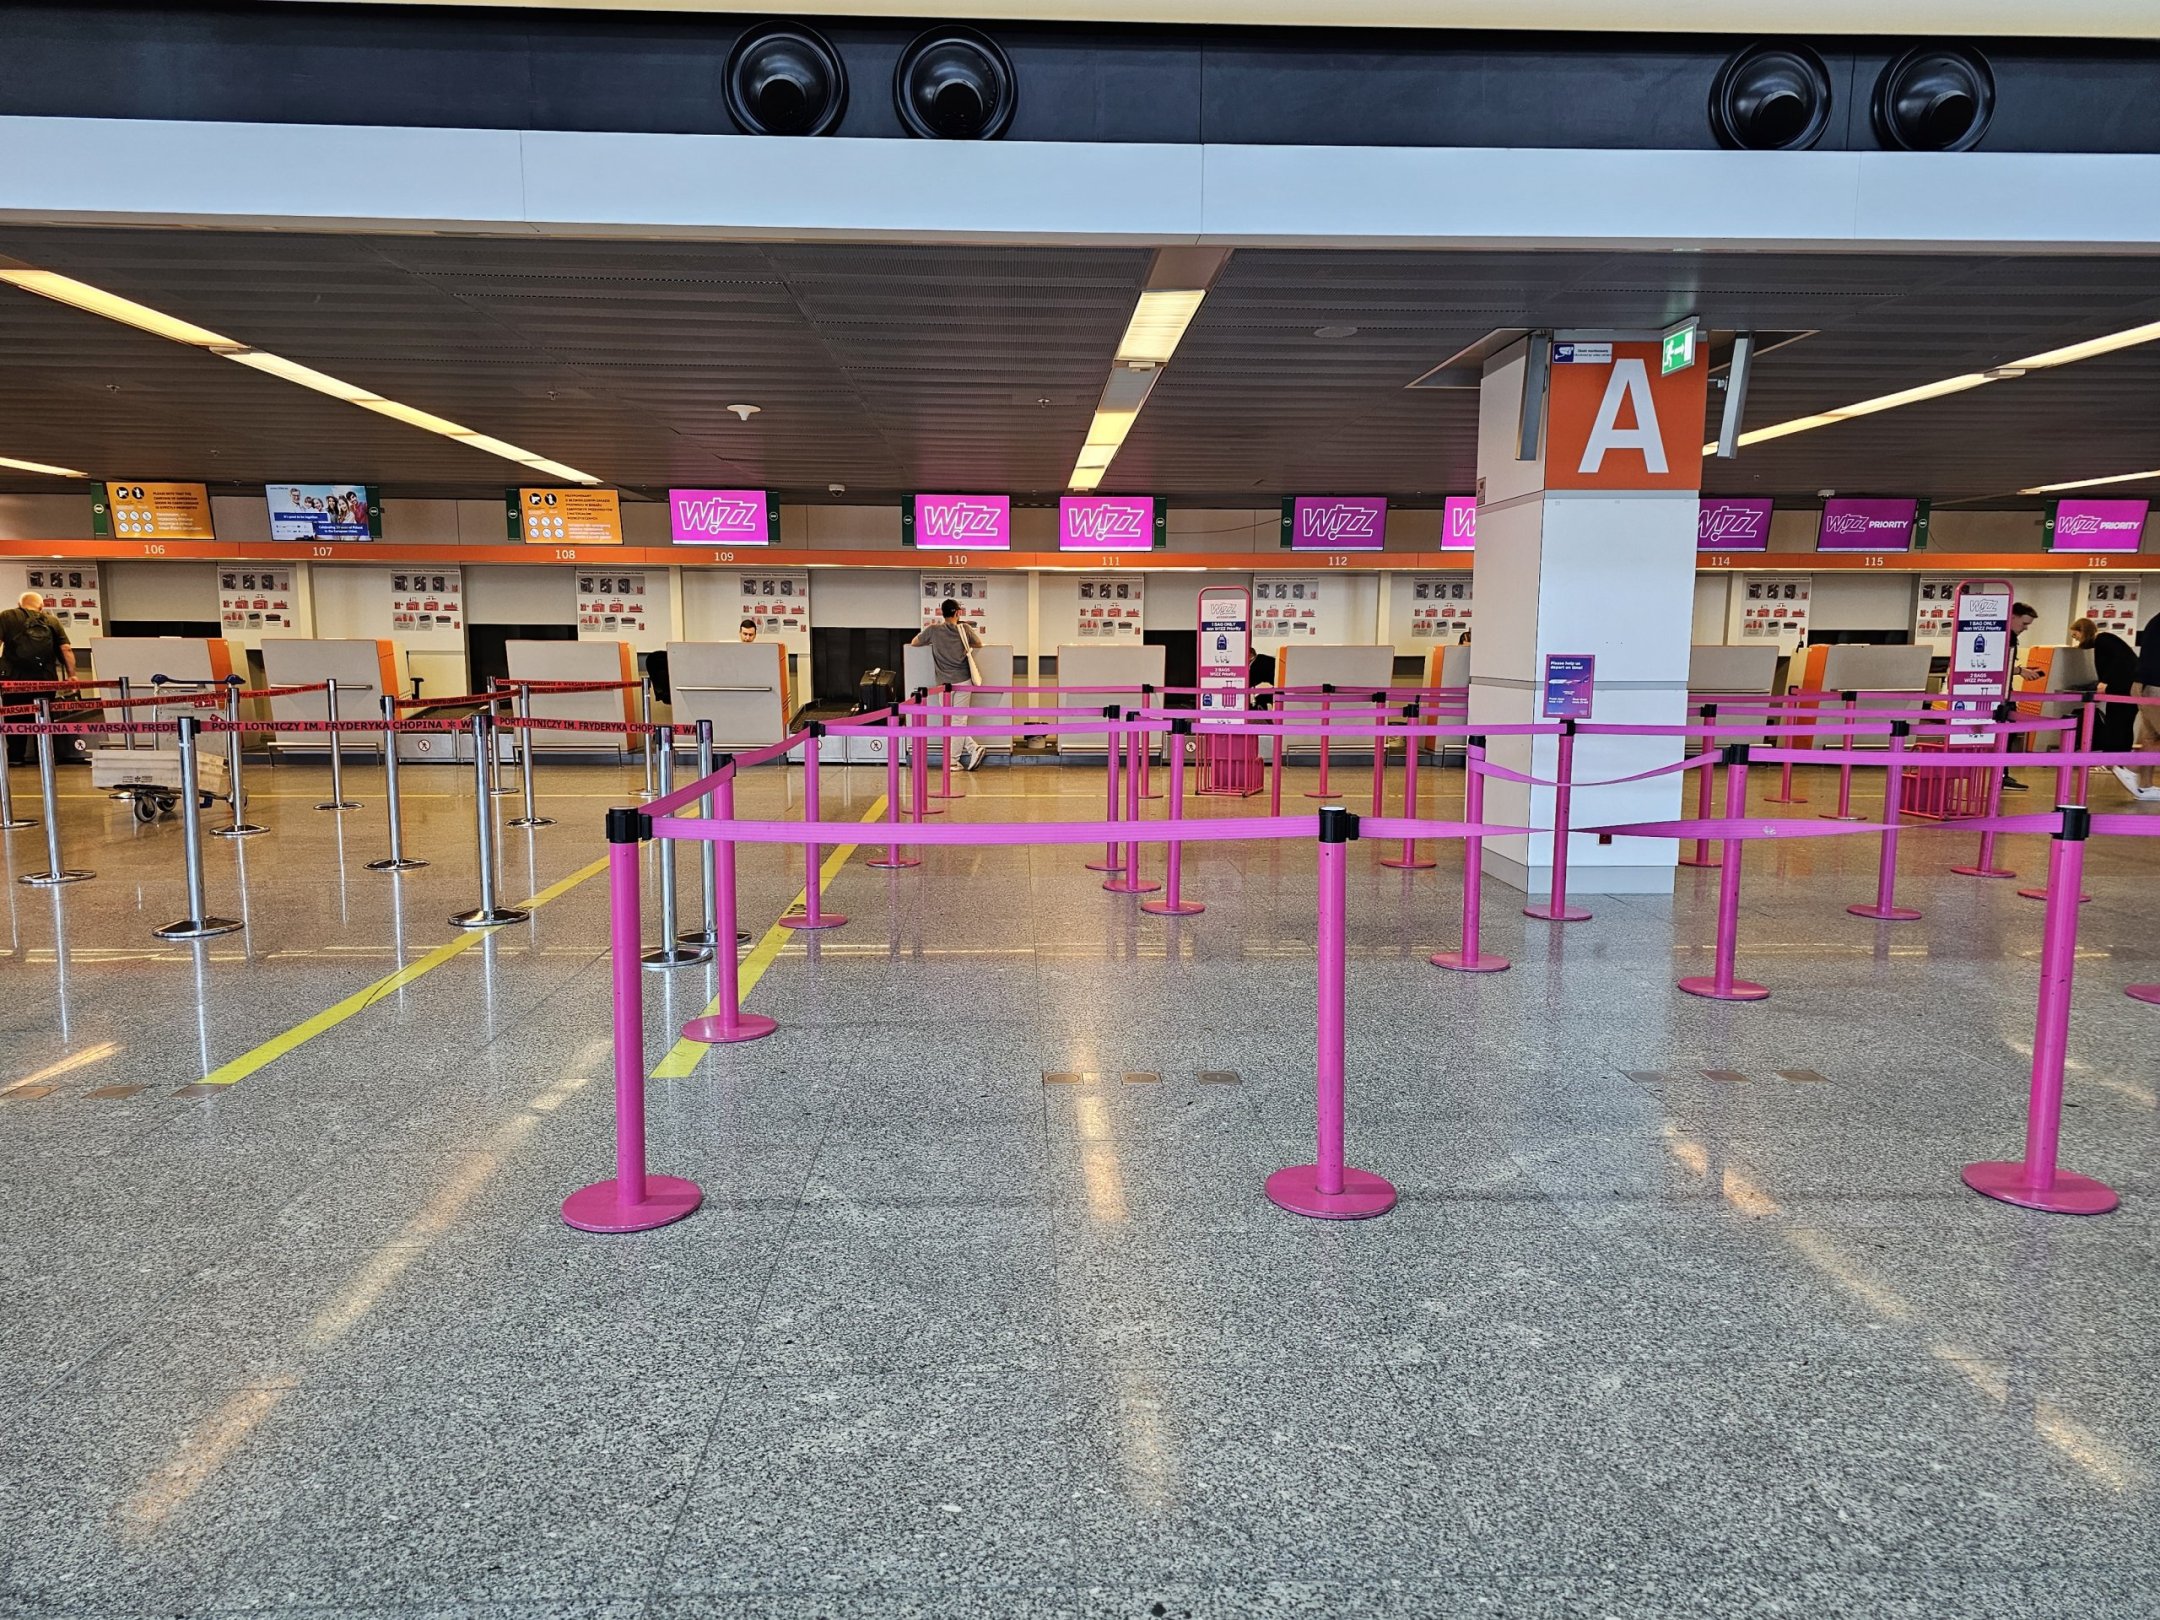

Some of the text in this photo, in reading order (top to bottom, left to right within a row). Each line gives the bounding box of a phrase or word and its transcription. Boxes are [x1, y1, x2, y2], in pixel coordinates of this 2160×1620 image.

[1578, 359, 1669, 473] A
[1869, 520, 1908, 529] PRIORITY
[2099, 521, 2140, 530] PRIORITY
[144, 544, 165, 554] 106
[313, 547, 332, 556] 107
[556, 550, 575, 560] 108
[715, 552, 734, 561] 109
[948, 556, 967, 565] 110
[1102, 556, 1120, 565] 111
[1328, 556, 1347, 566] 112
[1711, 557, 1730, 566] 114
[1864, 557, 1883, 566] 115
[2087, 557, 2107, 567] 116
[68, 701, 95, 709] LOTNICZY
[16, 724, 68, 733] CHOPINA
[87, 723, 138, 733] WARSAW
[142, 723, 177, 732] FREDE
[211, 720, 442, 731] PORT LOTNICZY IM. FRYDERYKA CHOPINA
[500, 717, 656, 733] PORT LOTNICZY IM. FRYDERYKA CHOPI
